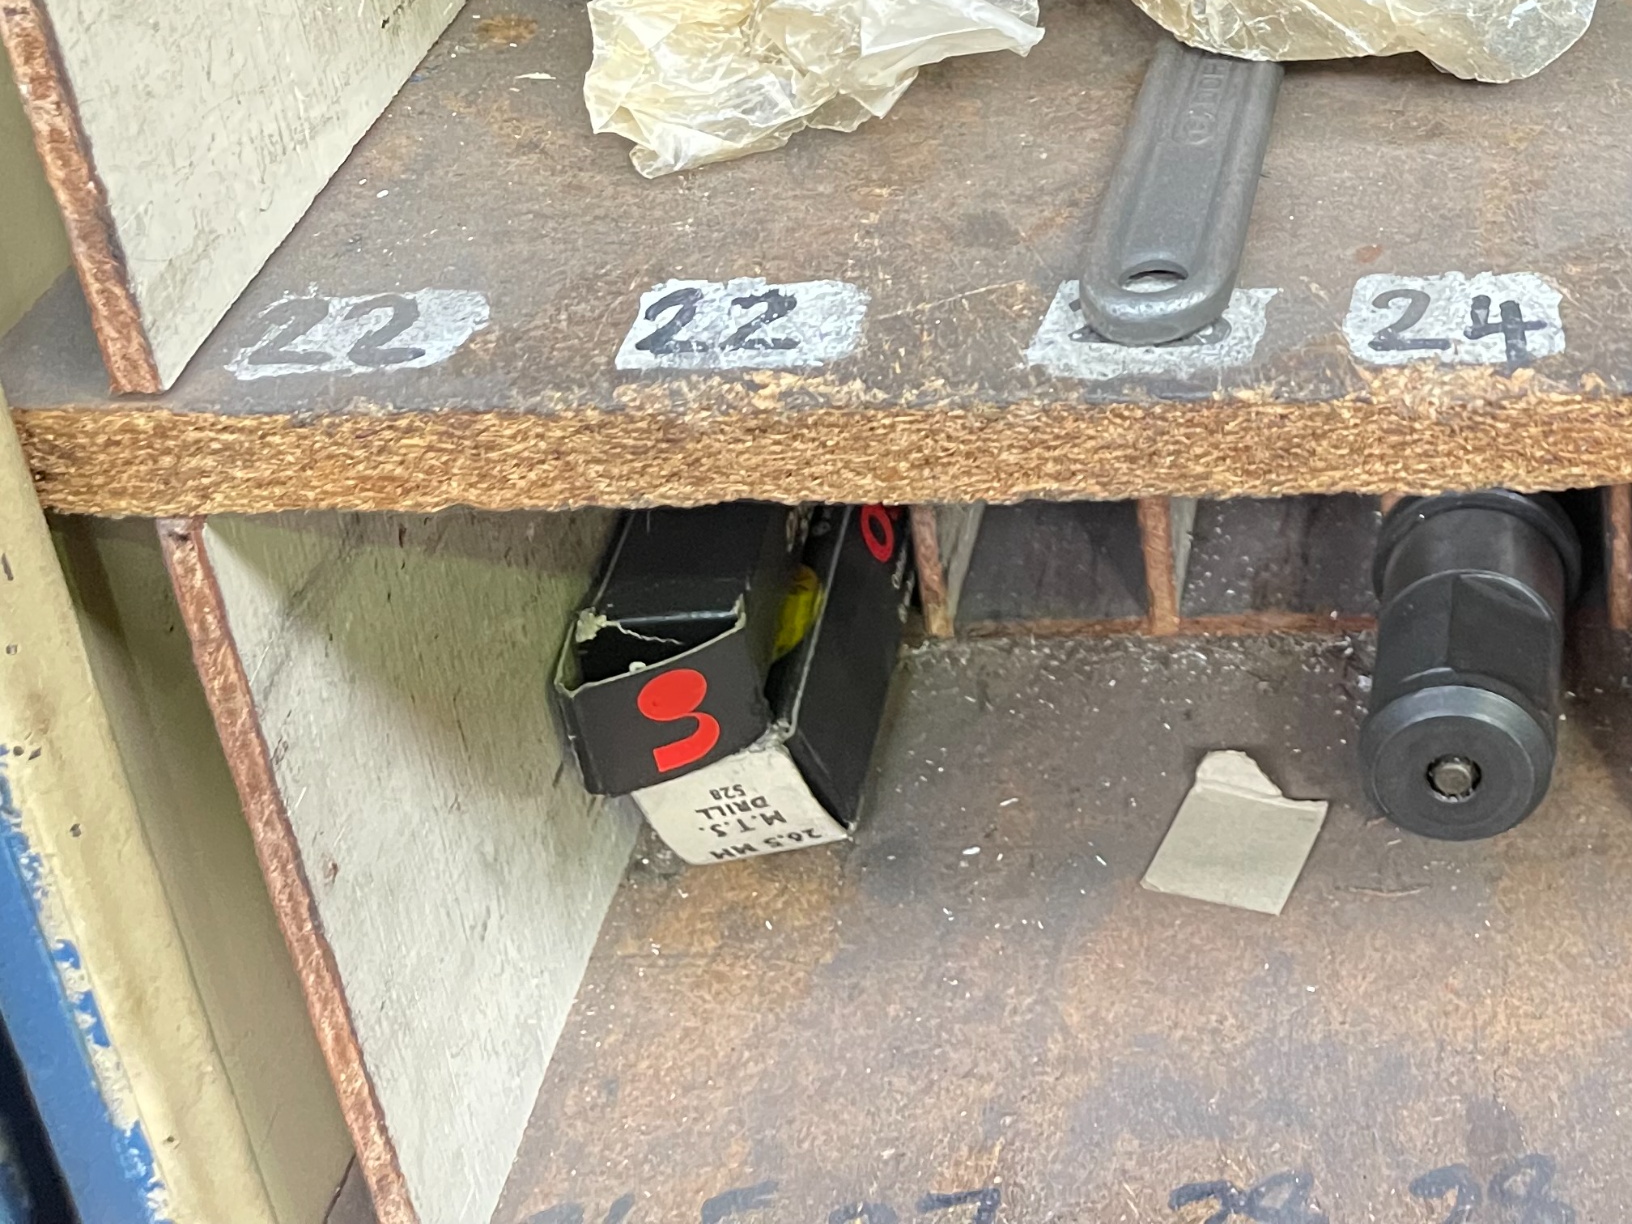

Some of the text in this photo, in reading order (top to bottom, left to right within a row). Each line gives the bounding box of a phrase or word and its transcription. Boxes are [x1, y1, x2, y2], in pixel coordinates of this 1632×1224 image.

[245, 291, 427, 366] 22
[633, 286, 803, 356] 22
[1371, 288, 1549, 374] 24
[695, 795, 770, 820] DRILL
[709, 842, 759, 860] MM
